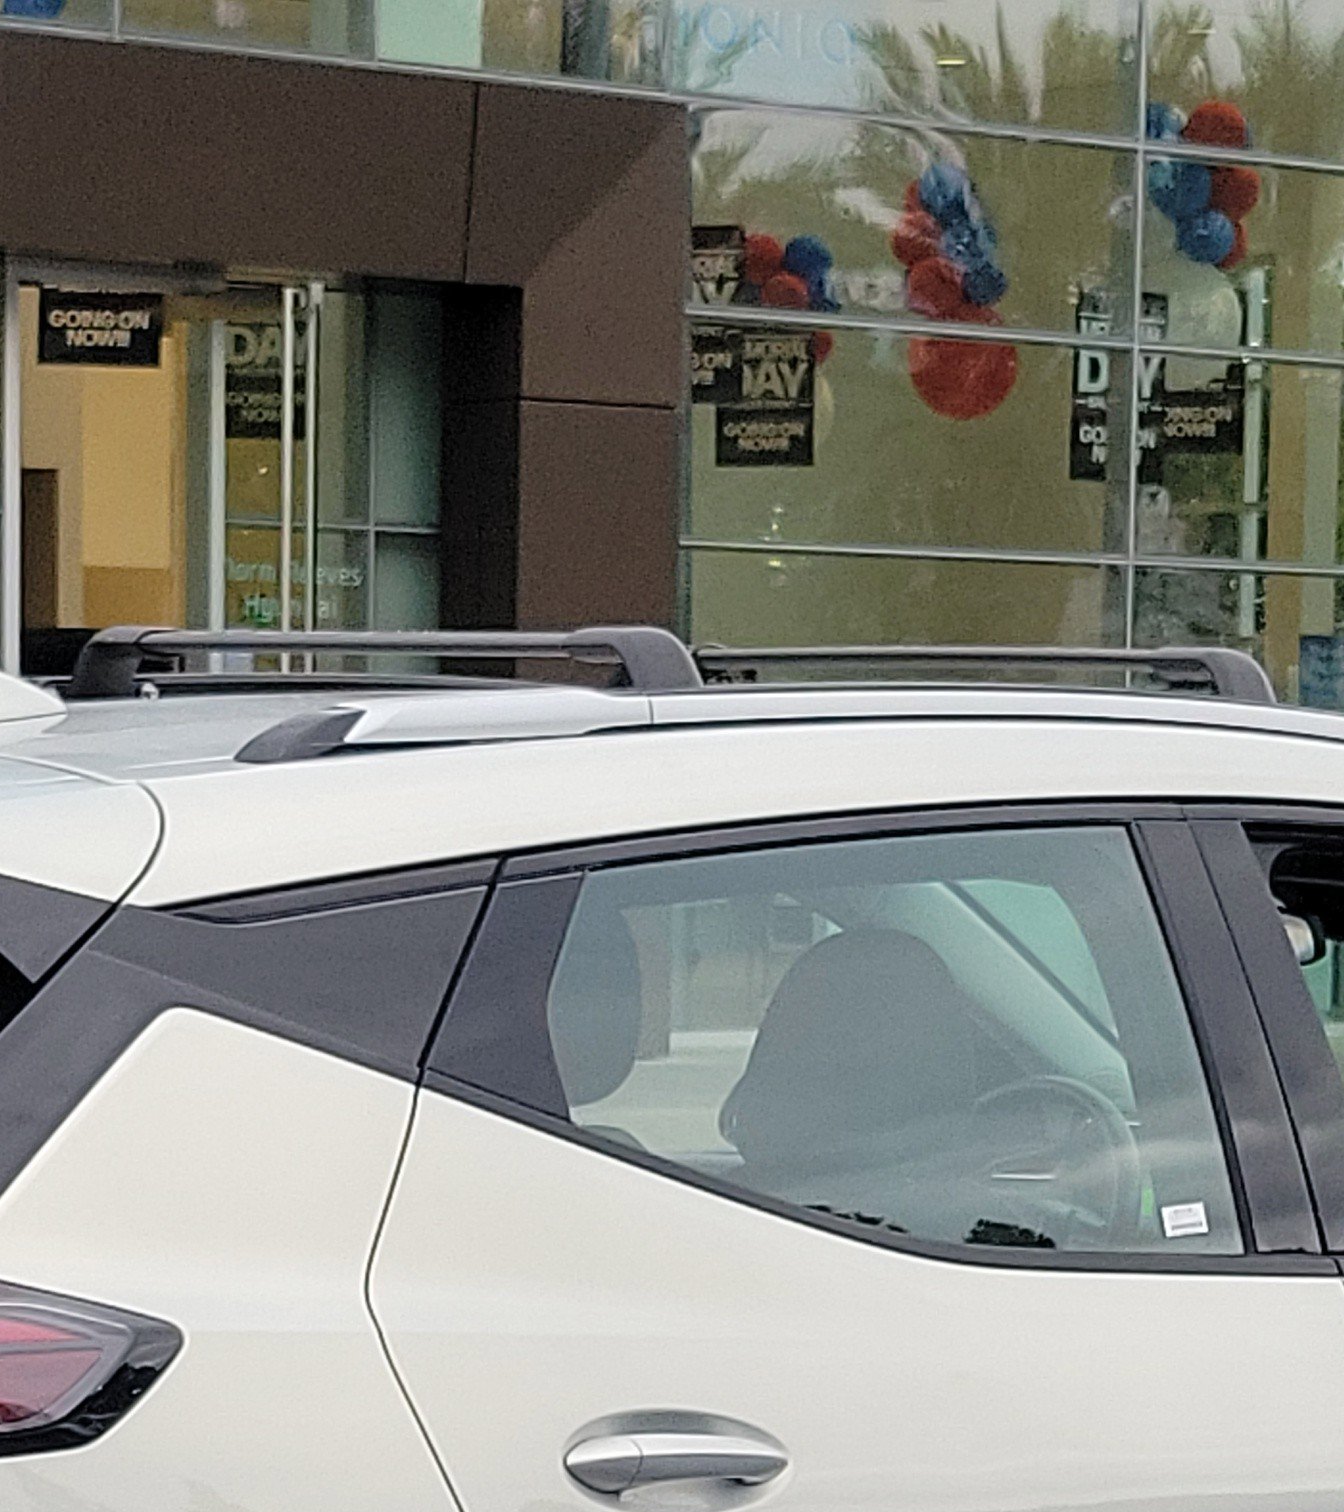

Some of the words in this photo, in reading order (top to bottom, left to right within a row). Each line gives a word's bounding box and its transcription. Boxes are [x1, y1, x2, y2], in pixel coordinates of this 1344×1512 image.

[48, 308, 116, 330] GOING
[118, 310, 151, 330] ON
[1077, 351, 1164, 398] DY
